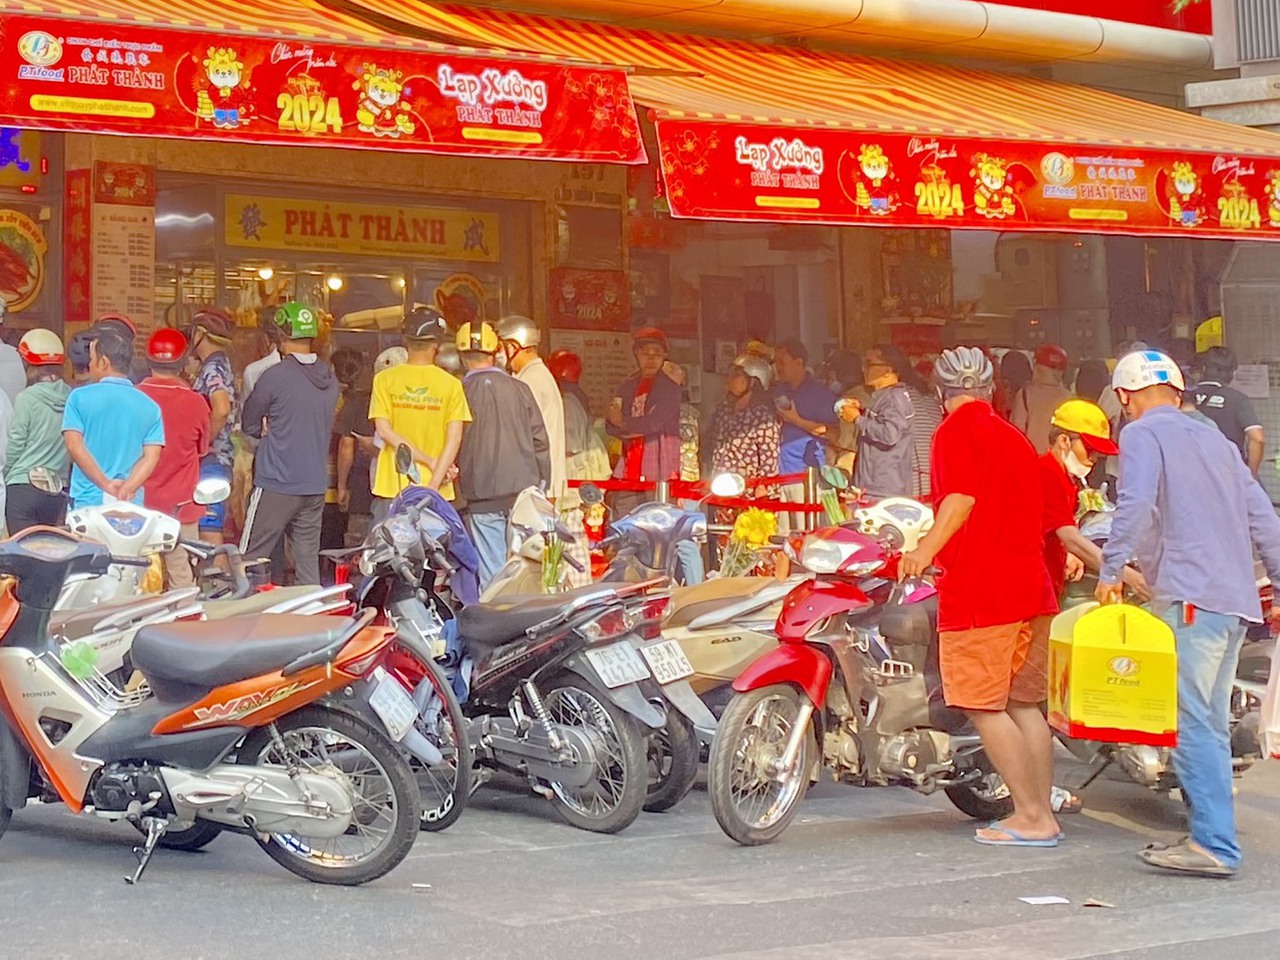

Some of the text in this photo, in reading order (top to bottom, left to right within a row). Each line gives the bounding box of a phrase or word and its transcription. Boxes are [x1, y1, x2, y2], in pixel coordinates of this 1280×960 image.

[68, 64, 165, 89] PHÁT THÀNH
[439, 66, 547, 109] Lạp Xưởng
[277, 93, 343, 133] 2024
[456, 104, 542, 128] PHÁT THÀNH
[736, 136, 822, 173] Lạp Xưởng
[915, 182, 964, 217] 2024
[1080, 180, 1148, 202] PHÁT THÀNH
[284, 204, 446, 245] PHÁT THÀNH
[1218, 197, 1261, 228] 2024
